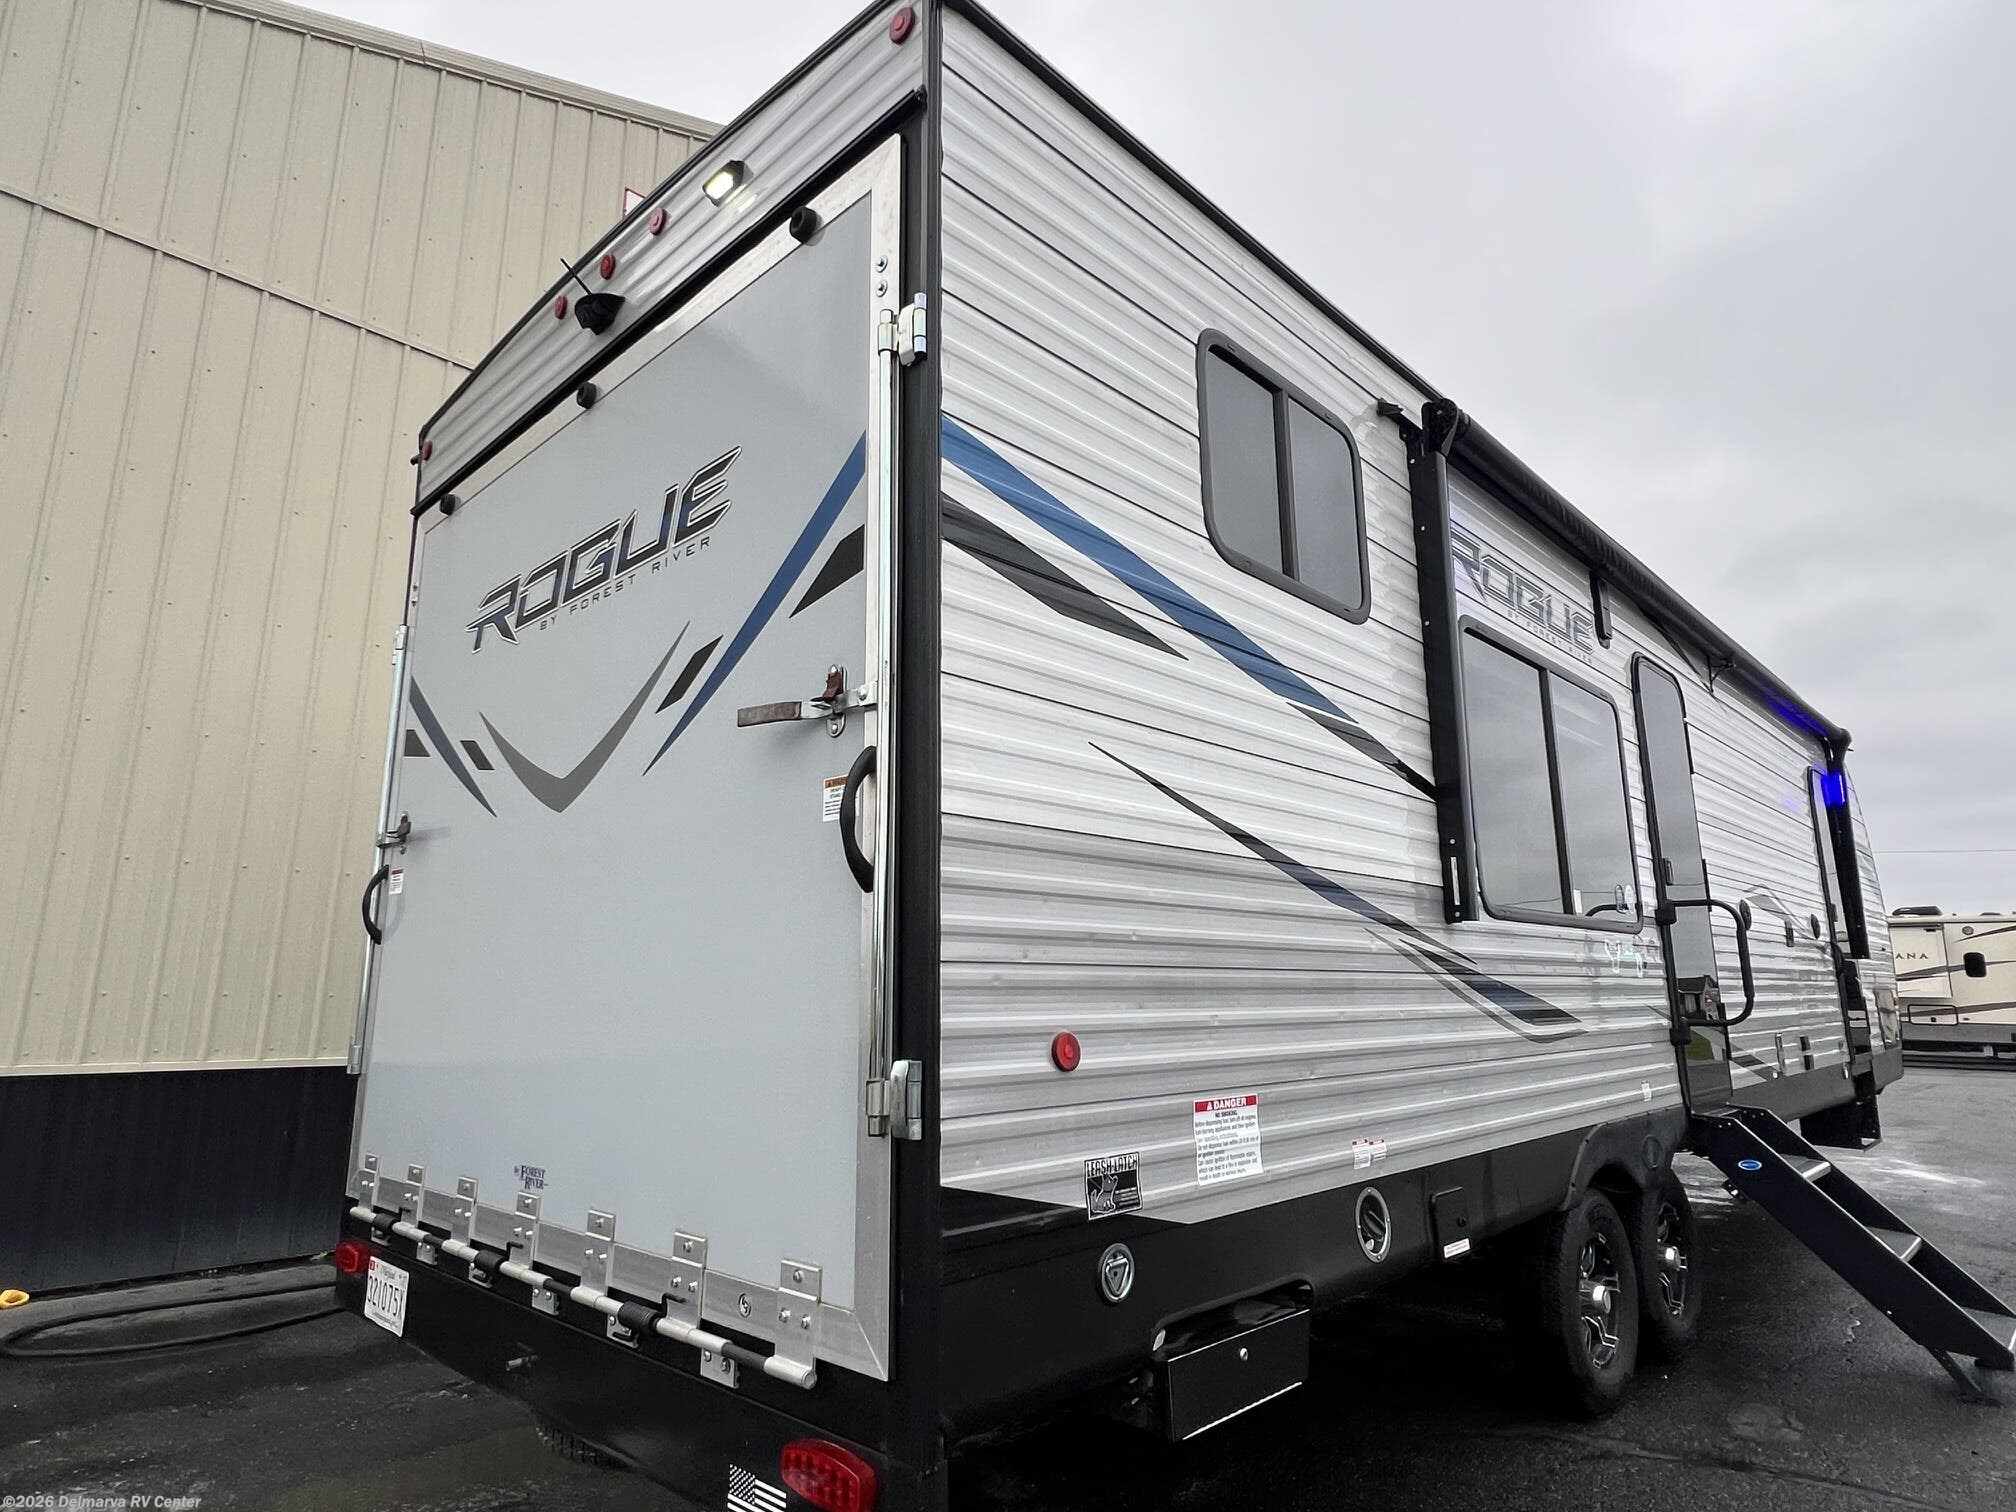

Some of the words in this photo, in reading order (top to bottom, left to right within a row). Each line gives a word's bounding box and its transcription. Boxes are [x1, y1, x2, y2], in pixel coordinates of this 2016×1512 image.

[465, 446, 742, 654] ROGUE
[540, 615, 558, 630] BY
[569, 574, 636, 616] FOREST
[651, 536, 711, 574] RIVER
[1450, 526, 1594, 656] ROGUE
[1213, 1097, 1247, 1111] DANGER
[521, 1165, 546, 1179] FOREST
[524, 1176, 544, 1190] RIVER
